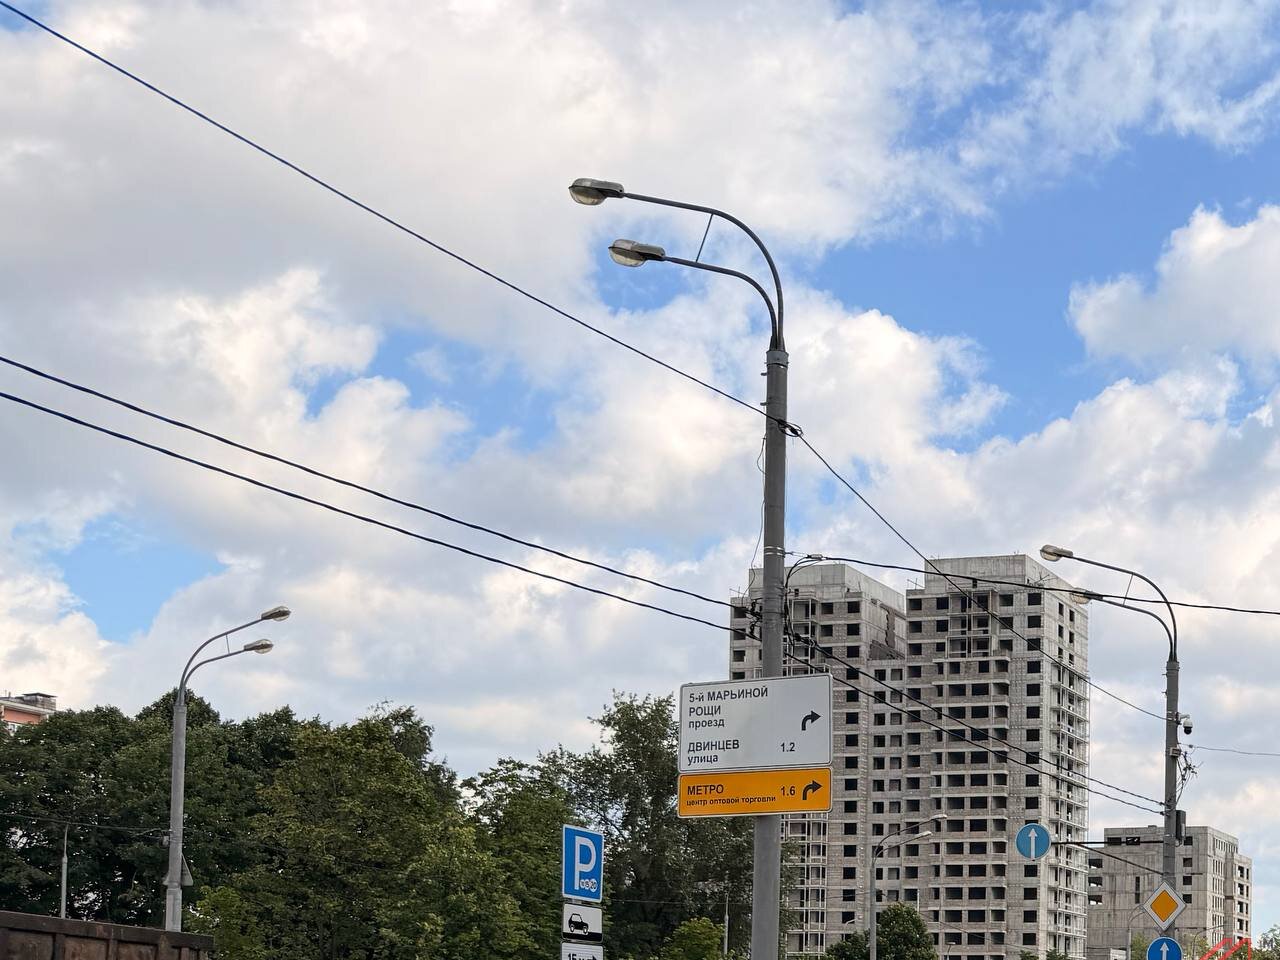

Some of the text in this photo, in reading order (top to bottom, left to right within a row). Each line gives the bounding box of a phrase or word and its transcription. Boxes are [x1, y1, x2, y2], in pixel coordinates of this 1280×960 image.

[689, 685, 768, 703] 5-й МАРЬИНОЙ
[689, 705, 721, 717] РОЩИ
[688, 718, 725, 730] проезд
[688, 739, 796, 753] ДВИНЦЕВ 1.2
[687, 754, 718, 766] улица
[687, 784, 796, 797] МЕТРО 1.6
[686, 795, 776, 807] центр оптовой торговли
